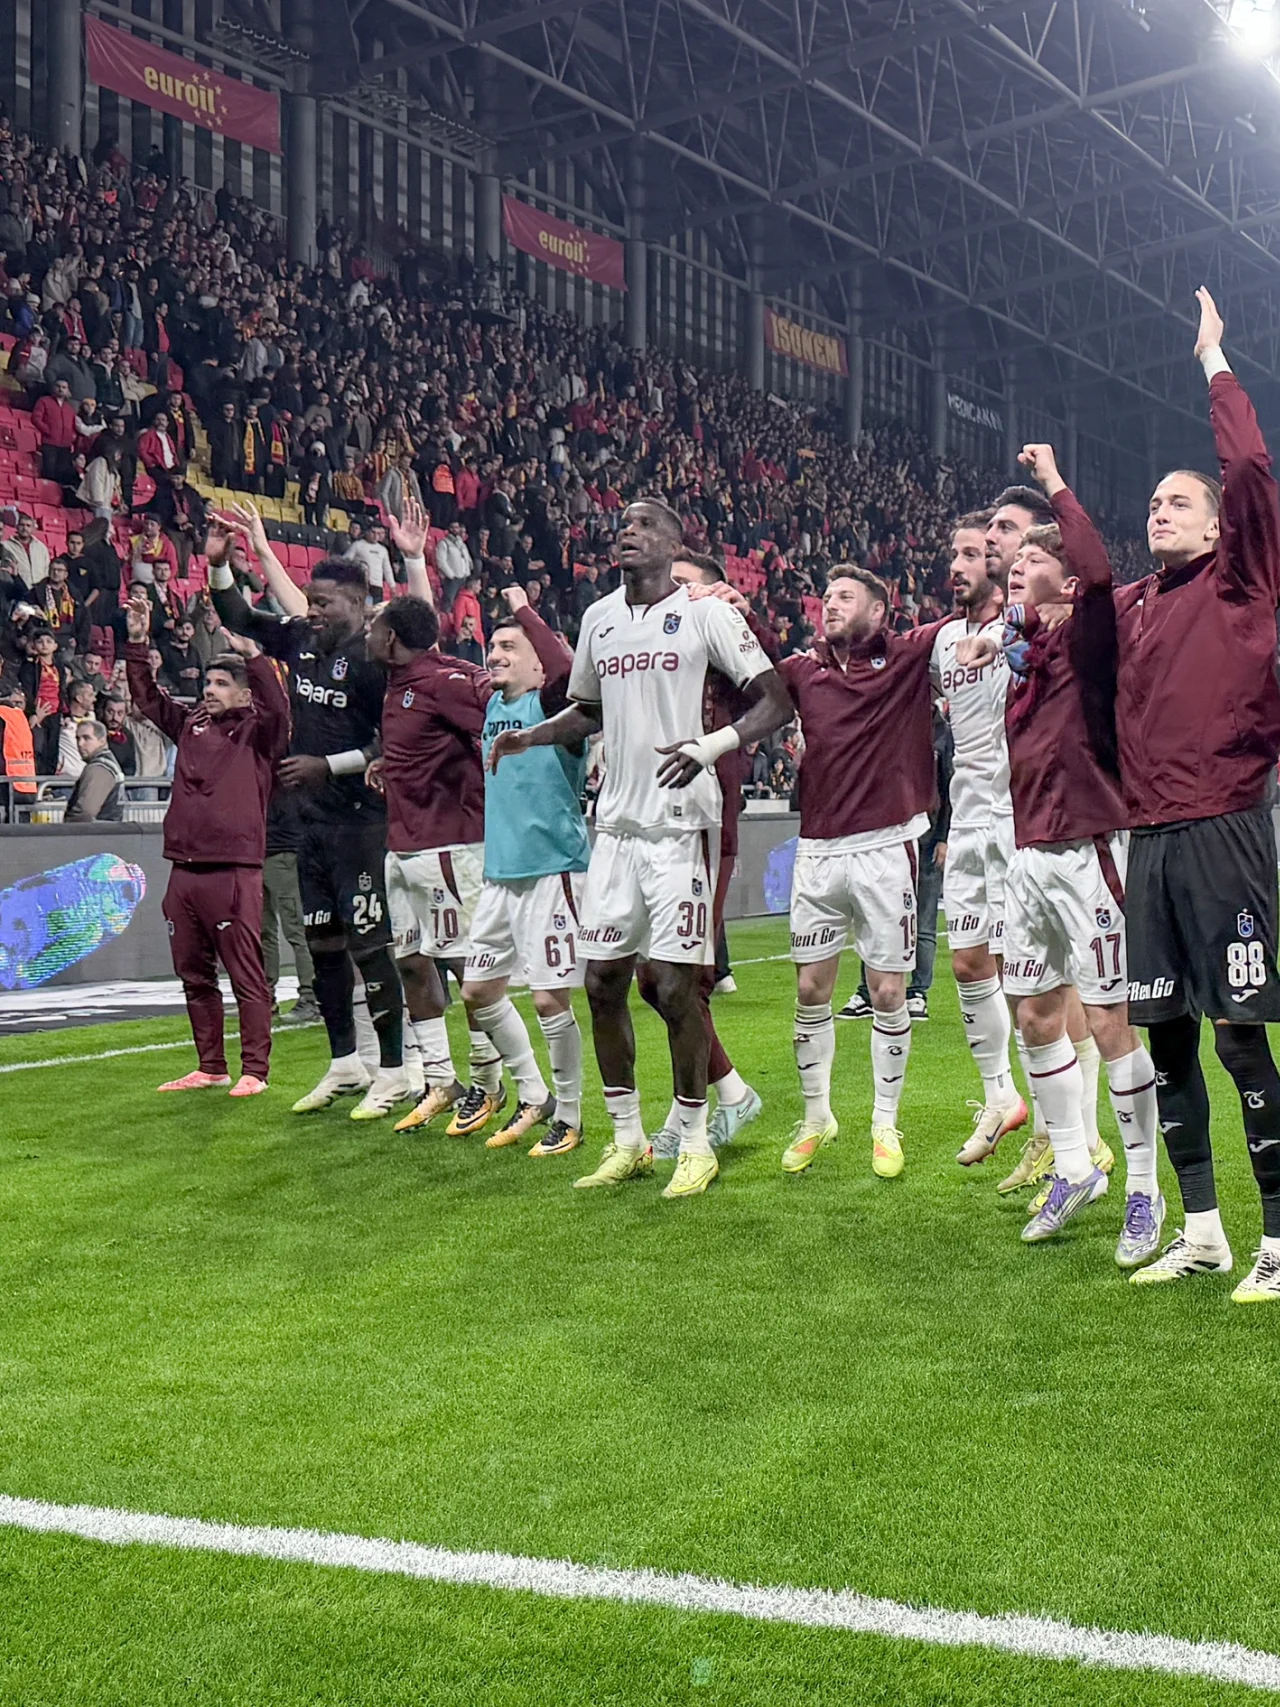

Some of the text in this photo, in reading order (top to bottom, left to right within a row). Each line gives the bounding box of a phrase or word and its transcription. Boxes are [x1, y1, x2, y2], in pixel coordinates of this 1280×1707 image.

[143, 66, 216, 114] euroil
[538, 231, 584, 263] euroil
[352, 893, 383, 925] 24
[430, 908, 459, 939] 10
[677, 902, 707, 938] 30
[961, 914, 979, 931] Go
[602, 926, 622, 942] Go
[820, 927, 836, 945] Go
[544, 933, 577, 968] 61
[1089, 933, 1121, 978] 17
[1227, 941, 1267, 988] 88
[1003, 959, 1043, 977] ent Go
